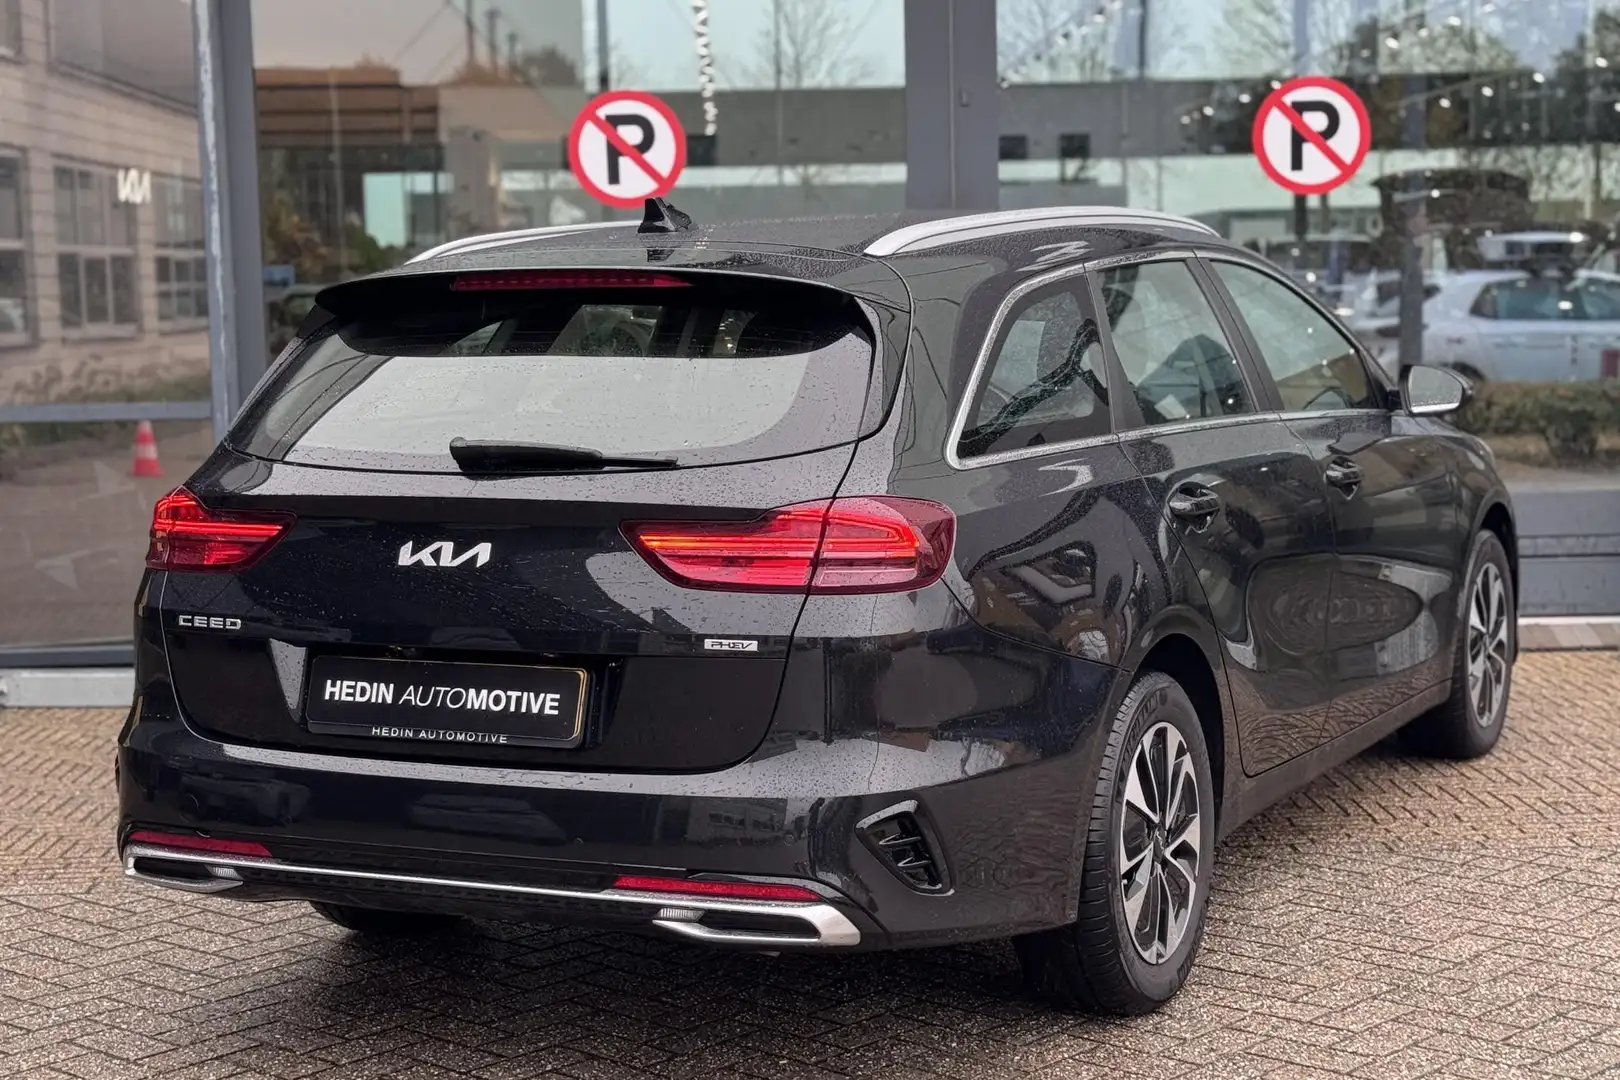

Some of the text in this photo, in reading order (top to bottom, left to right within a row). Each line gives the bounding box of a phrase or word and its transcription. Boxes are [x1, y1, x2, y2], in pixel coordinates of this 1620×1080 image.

[604, 113, 655, 185] P
[1290, 100, 1340, 171] P
[398, 540, 492, 568] KIA
[179, 614, 242, 630] CEED
[709, 640, 754, 651] PHEV
[324, 679, 561, 715] HEDIN AUTOMOTIVE
[371, 726, 509, 744] HEDIN AUTOMOTIVE
